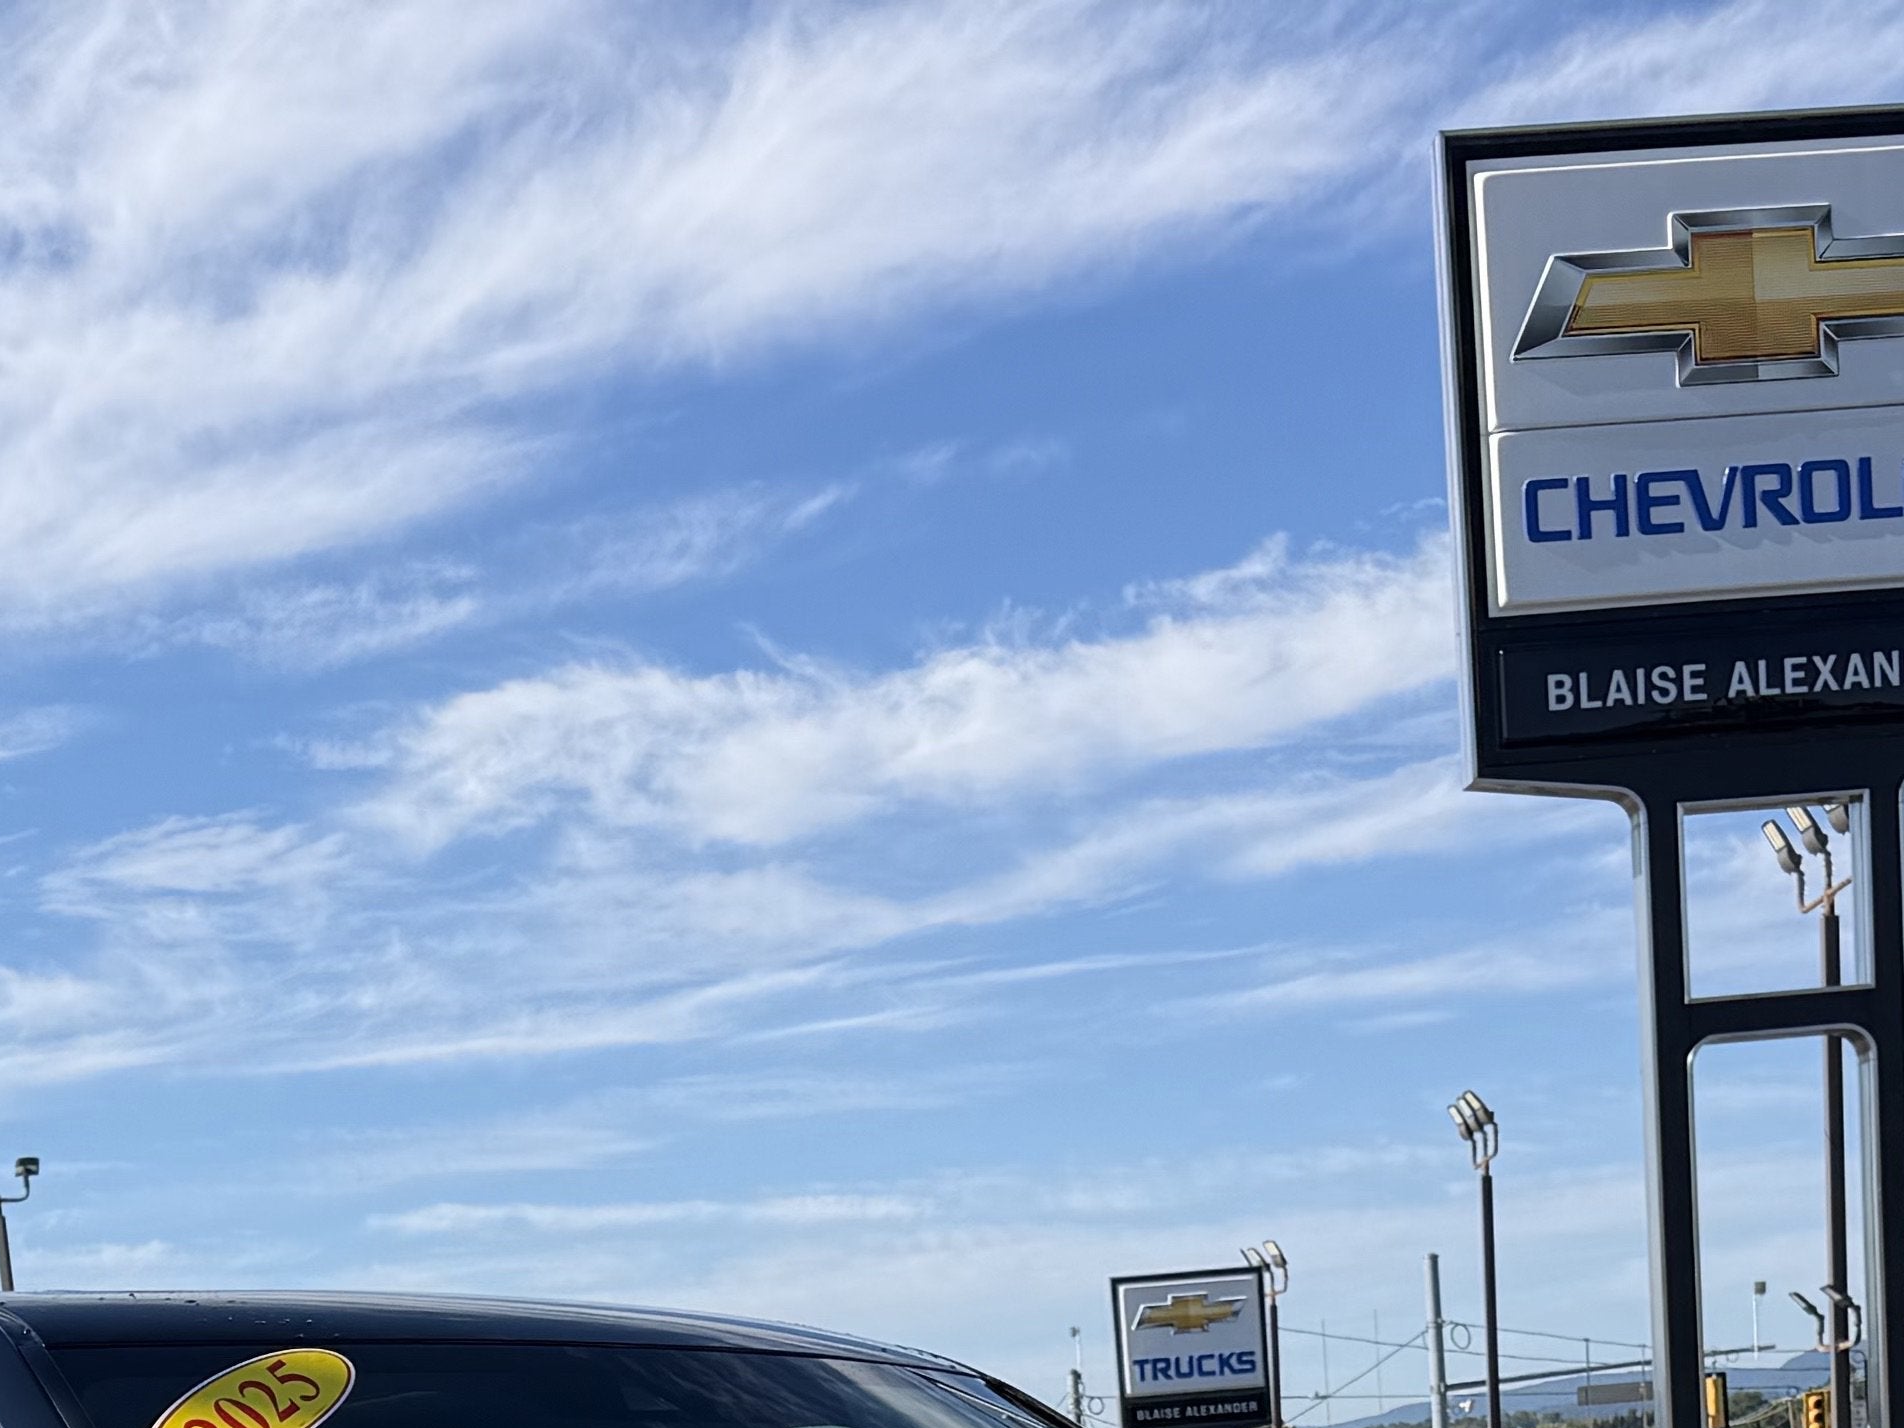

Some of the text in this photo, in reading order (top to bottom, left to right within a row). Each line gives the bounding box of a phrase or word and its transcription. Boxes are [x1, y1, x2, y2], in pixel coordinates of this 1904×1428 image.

[1546, 663, 1708, 711] BLAISE
[1133, 1350, 1257, 1382] TRUCKS
[1136, 1401, 1258, 1421] BLAISE ALEXANDER
